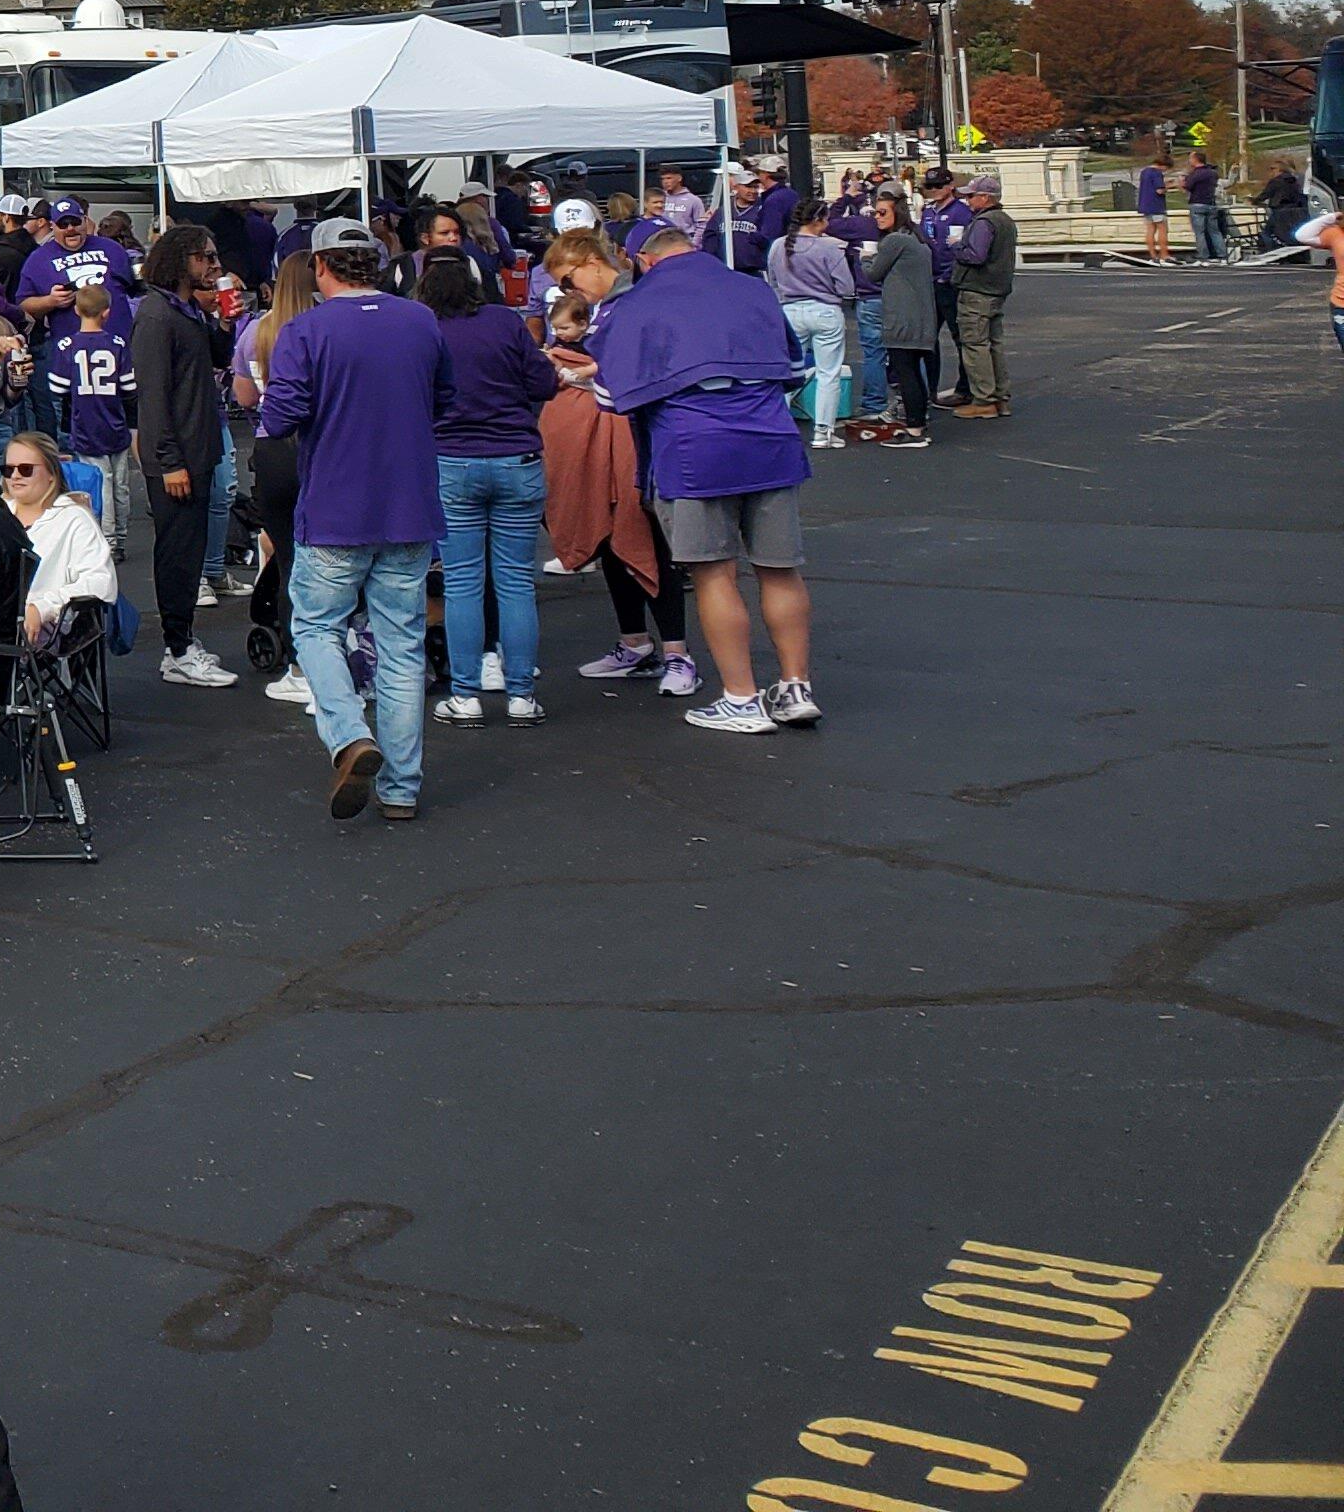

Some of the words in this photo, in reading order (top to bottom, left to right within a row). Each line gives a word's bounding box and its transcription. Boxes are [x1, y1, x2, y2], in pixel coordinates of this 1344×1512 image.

[51, 250, 109, 272] K-STATE
[74, 349, 117, 396] 12
[872, 1239, 1163, 1412] ROW
